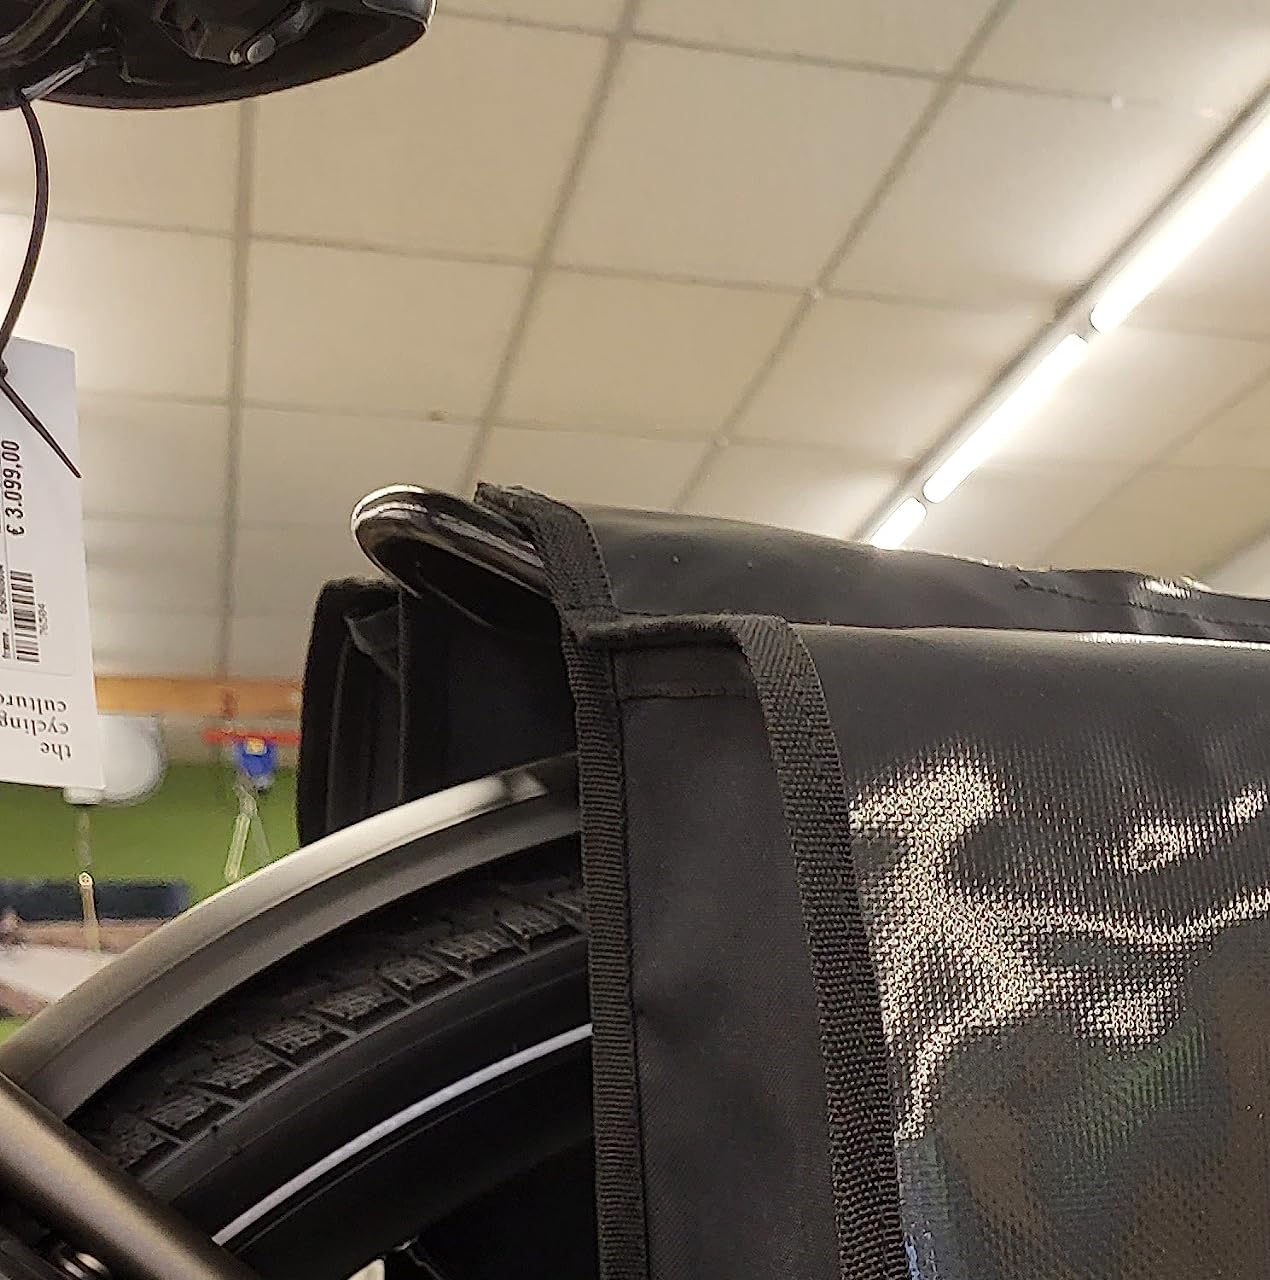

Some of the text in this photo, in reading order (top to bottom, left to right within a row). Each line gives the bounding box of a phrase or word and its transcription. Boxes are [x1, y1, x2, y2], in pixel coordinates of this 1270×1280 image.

[1, 440, 25, 536] € 3.099,00
[40, 741, 71, 760] the
